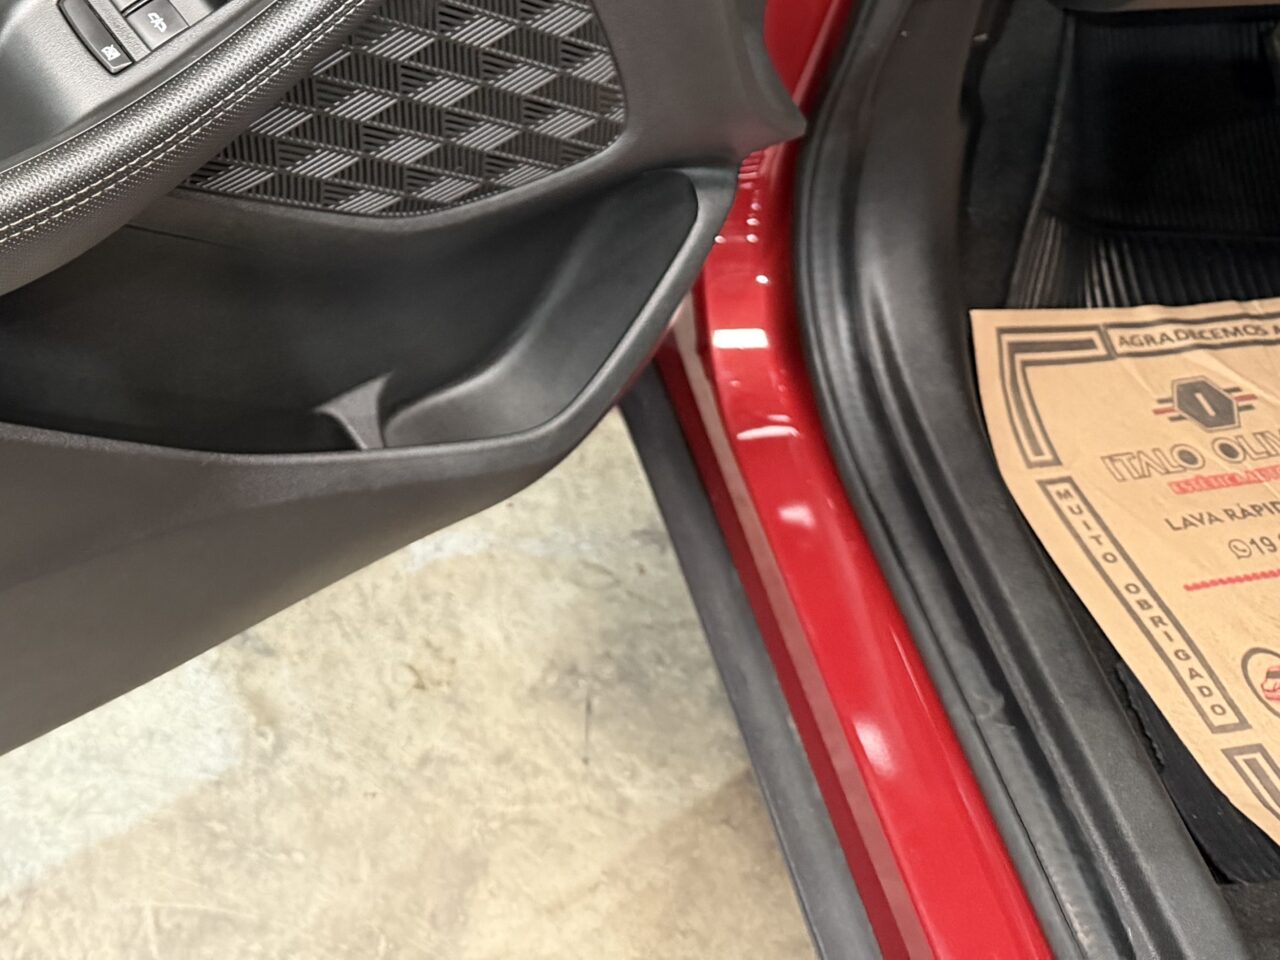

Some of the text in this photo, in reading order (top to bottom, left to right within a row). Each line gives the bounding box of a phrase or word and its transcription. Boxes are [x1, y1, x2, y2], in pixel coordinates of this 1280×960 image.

[1100, 443, 1206, 483] ITALO
[1164, 510, 1224, 532] LAVA
[1249, 535, 1278, 556] 19
[1055, 488, 1228, 717] MUITO OBRIGADO
